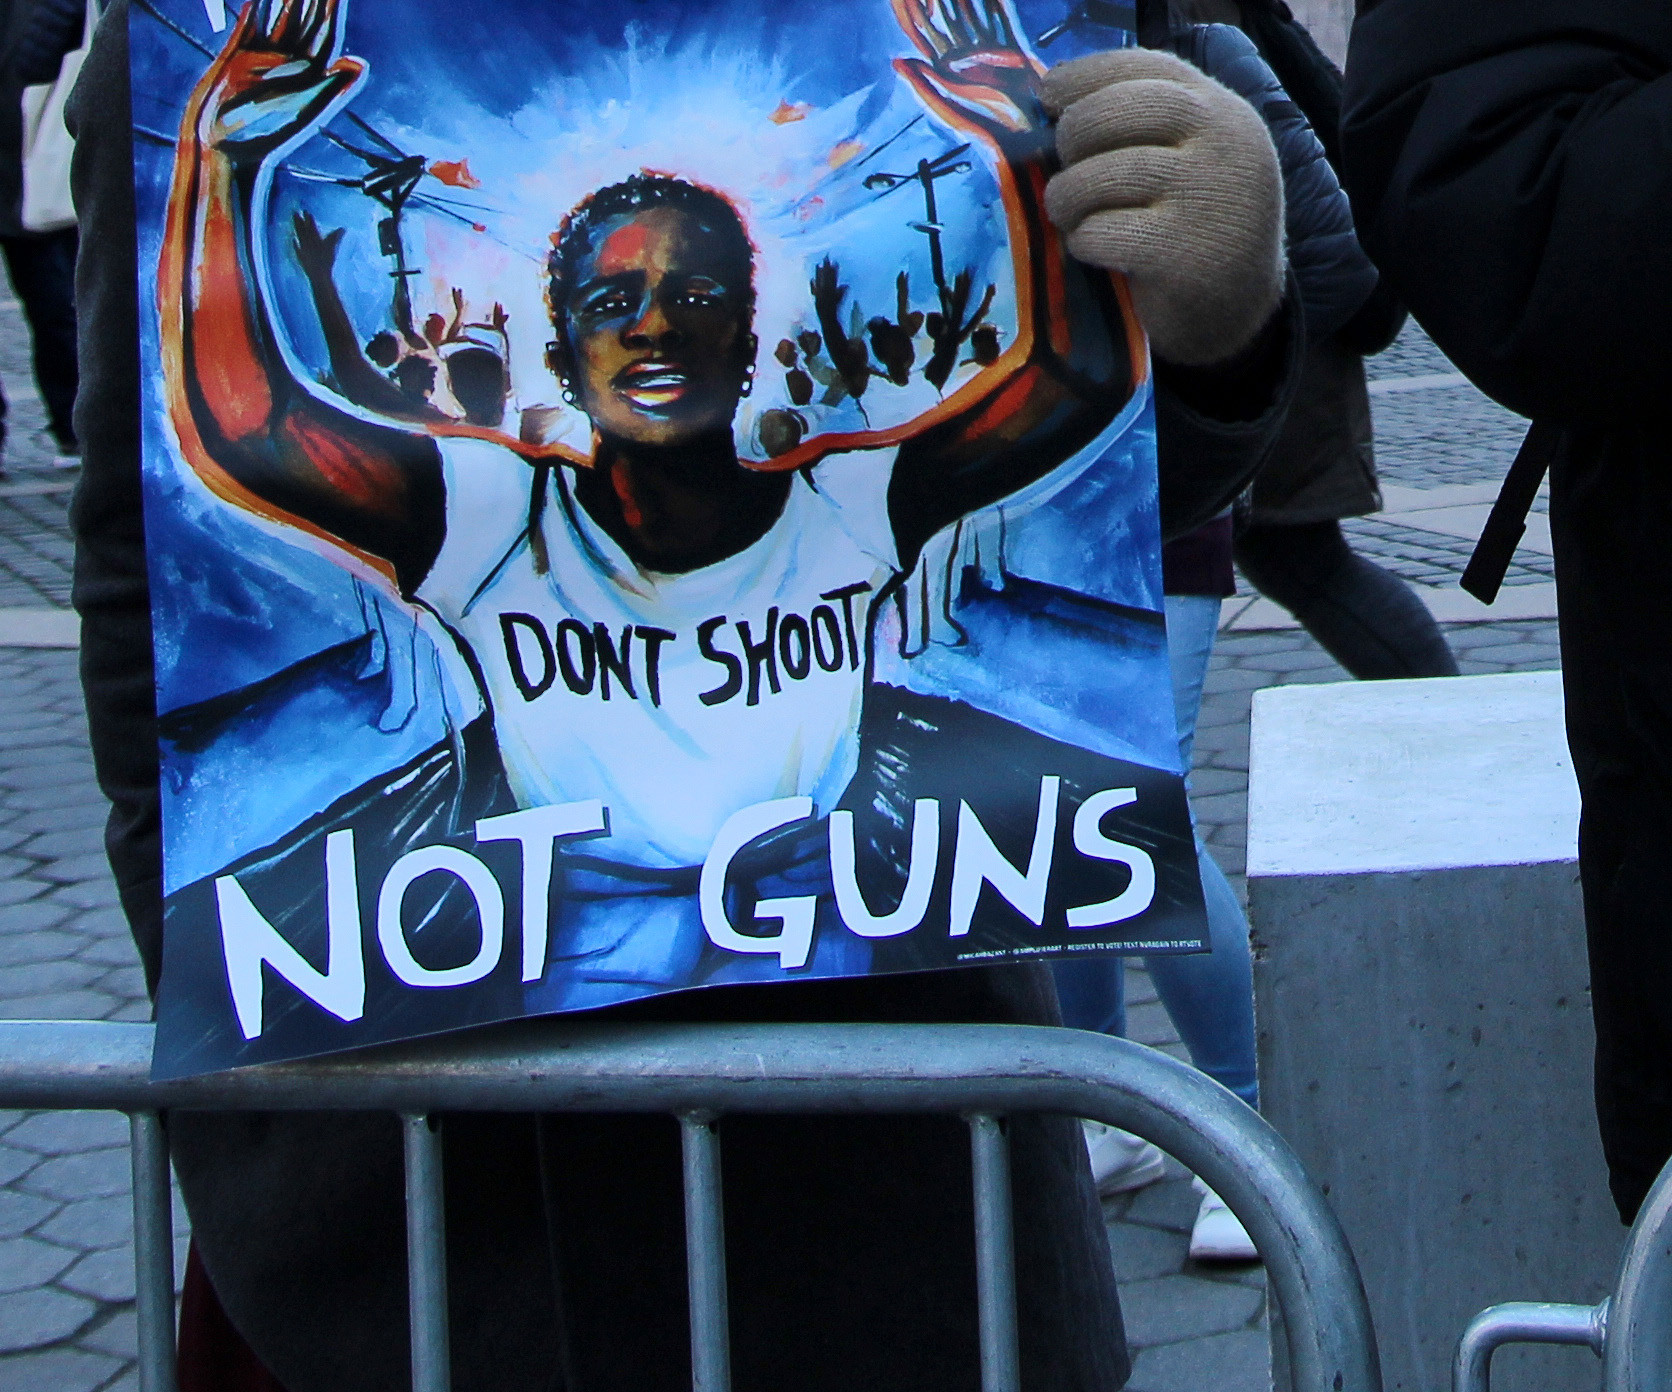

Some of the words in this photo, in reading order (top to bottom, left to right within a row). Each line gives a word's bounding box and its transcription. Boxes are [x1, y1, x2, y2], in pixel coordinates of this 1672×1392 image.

[498, 612, 677, 709] DONT
[696, 580, 873, 708] SHOOT
[215, 799, 607, 1040] NOT
[697, 774, 1156, 970] GUNS
